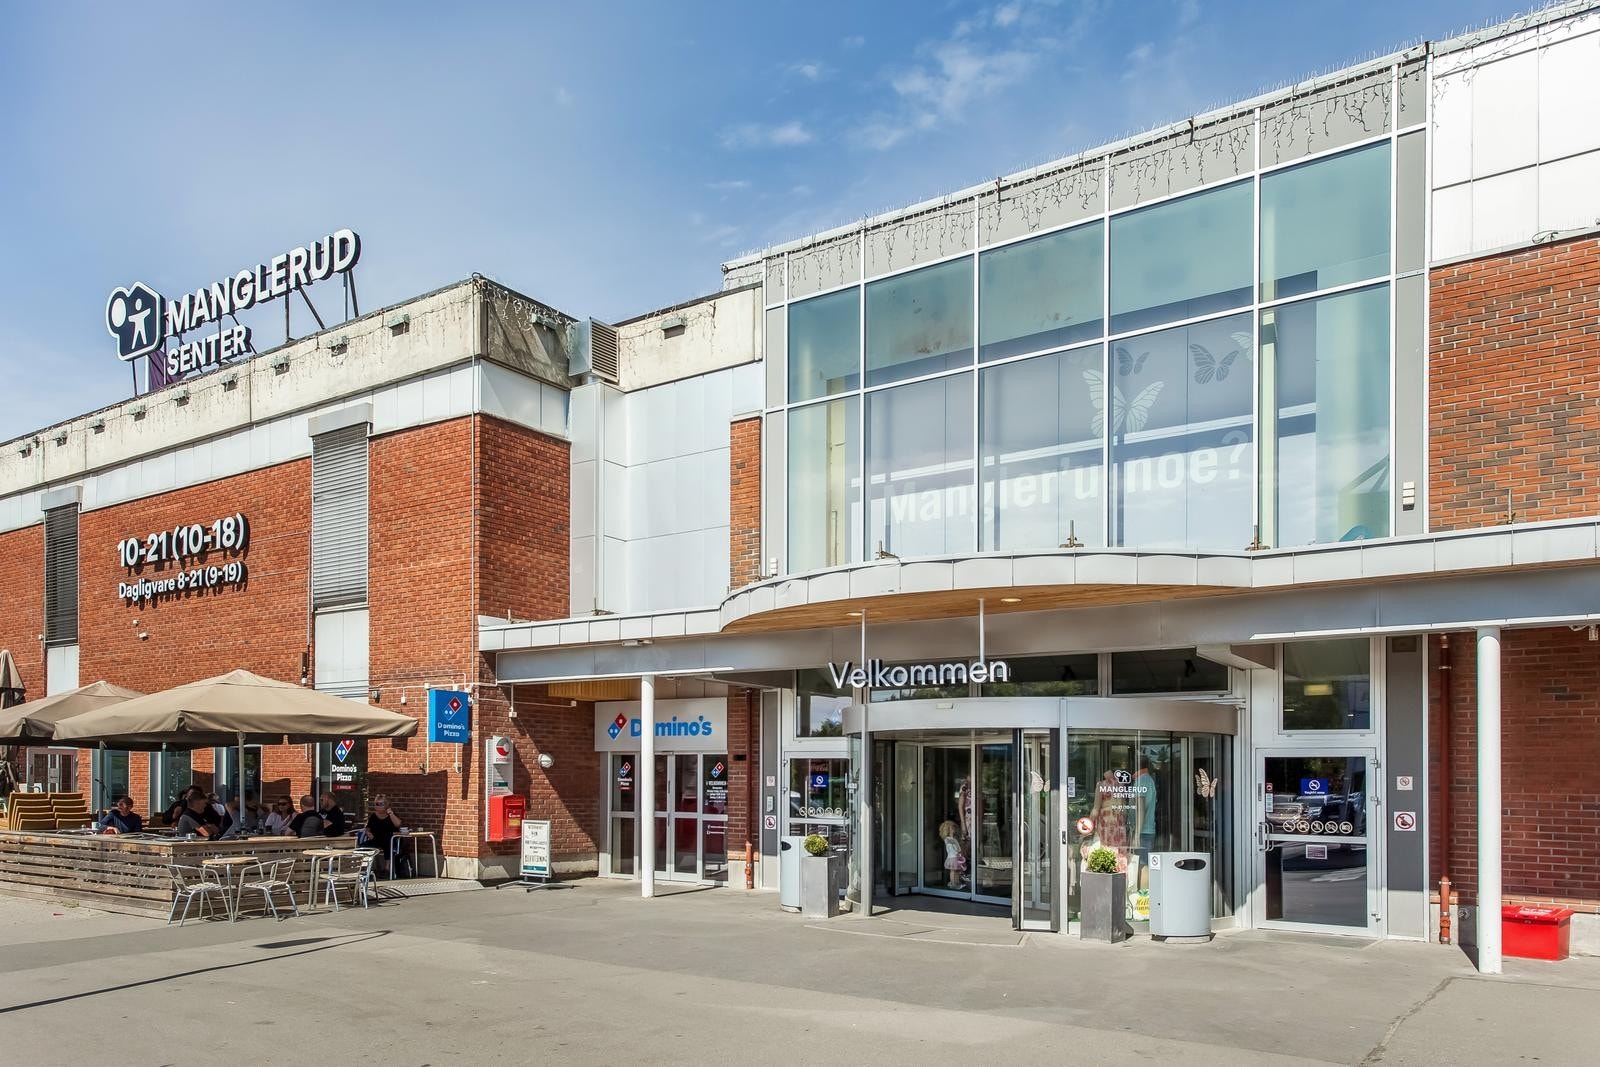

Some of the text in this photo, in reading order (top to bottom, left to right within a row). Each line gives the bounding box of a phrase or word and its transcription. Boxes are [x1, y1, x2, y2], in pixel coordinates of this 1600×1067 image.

[166, 228, 361, 337] MANGLERUD
[167, 324, 251, 376] SENTER
[1123, 430, 1249, 493] noe?
[117, 512, 246, 567] 10-21 (10-18)
[118, 561, 243, 602] Dagligvare 8-21 (9-19)
[828, 659, 1008, 689] Velkommen
[437, 722, 465, 730] Domino's
[443, 729, 460, 737] Pizza
[630, 715, 713, 737] Dmino's
[331, 763, 357, 773] Domino's
[336, 772, 352, 782] Pizza
[1099, 785, 1148, 793] MANGLERUD
